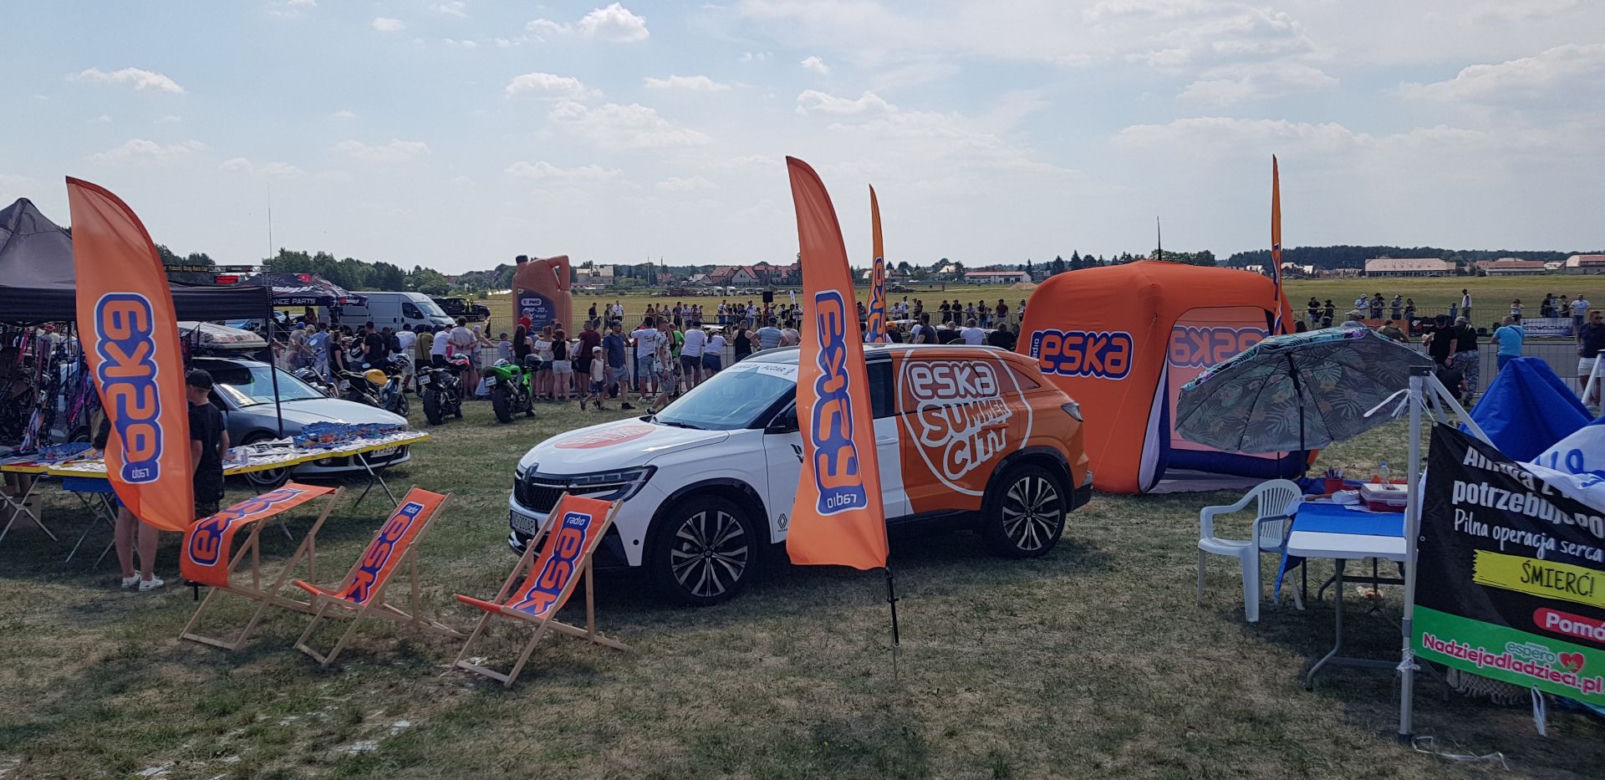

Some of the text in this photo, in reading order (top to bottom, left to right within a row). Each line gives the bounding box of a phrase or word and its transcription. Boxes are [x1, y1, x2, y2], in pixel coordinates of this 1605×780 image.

[1041, 333, 1128, 376] eska
[911, 365, 996, 396] eska
[920, 400, 1010, 443] SUMMER
[946, 422, 1008, 476] CITY
[1454, 508, 1604, 562] Pilna operacja serca
[516, 527, 583, 613] esk
[1520, 560, 1595, 597] ŚMIERĆ!
[1422, 633, 1602, 693] Nadziejadladzieci.pl
[1506, 641, 1557, 663] espero
